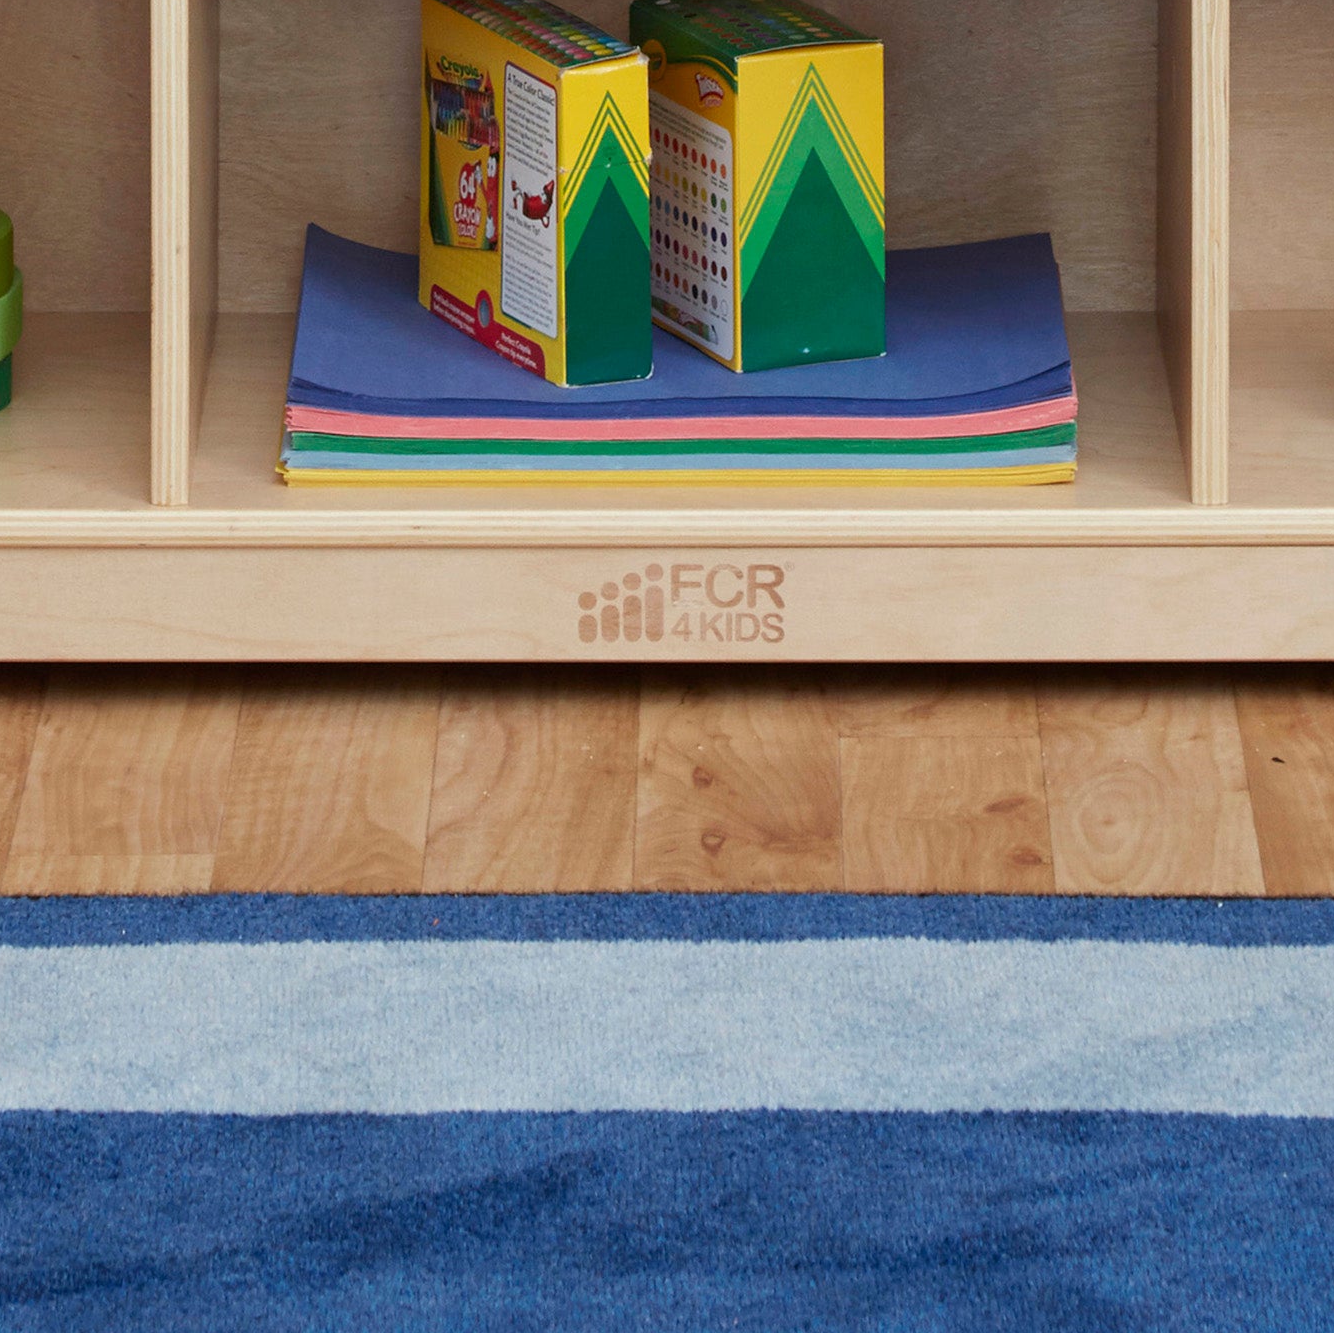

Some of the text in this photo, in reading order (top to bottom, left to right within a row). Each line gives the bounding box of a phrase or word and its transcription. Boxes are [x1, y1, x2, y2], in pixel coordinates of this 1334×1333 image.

[460, 170, 476, 200] 64
[453, 202, 482, 227] CRAYON
[670, 563, 786, 609] FCR
[670, 612, 786, 643] 4 KIDS
